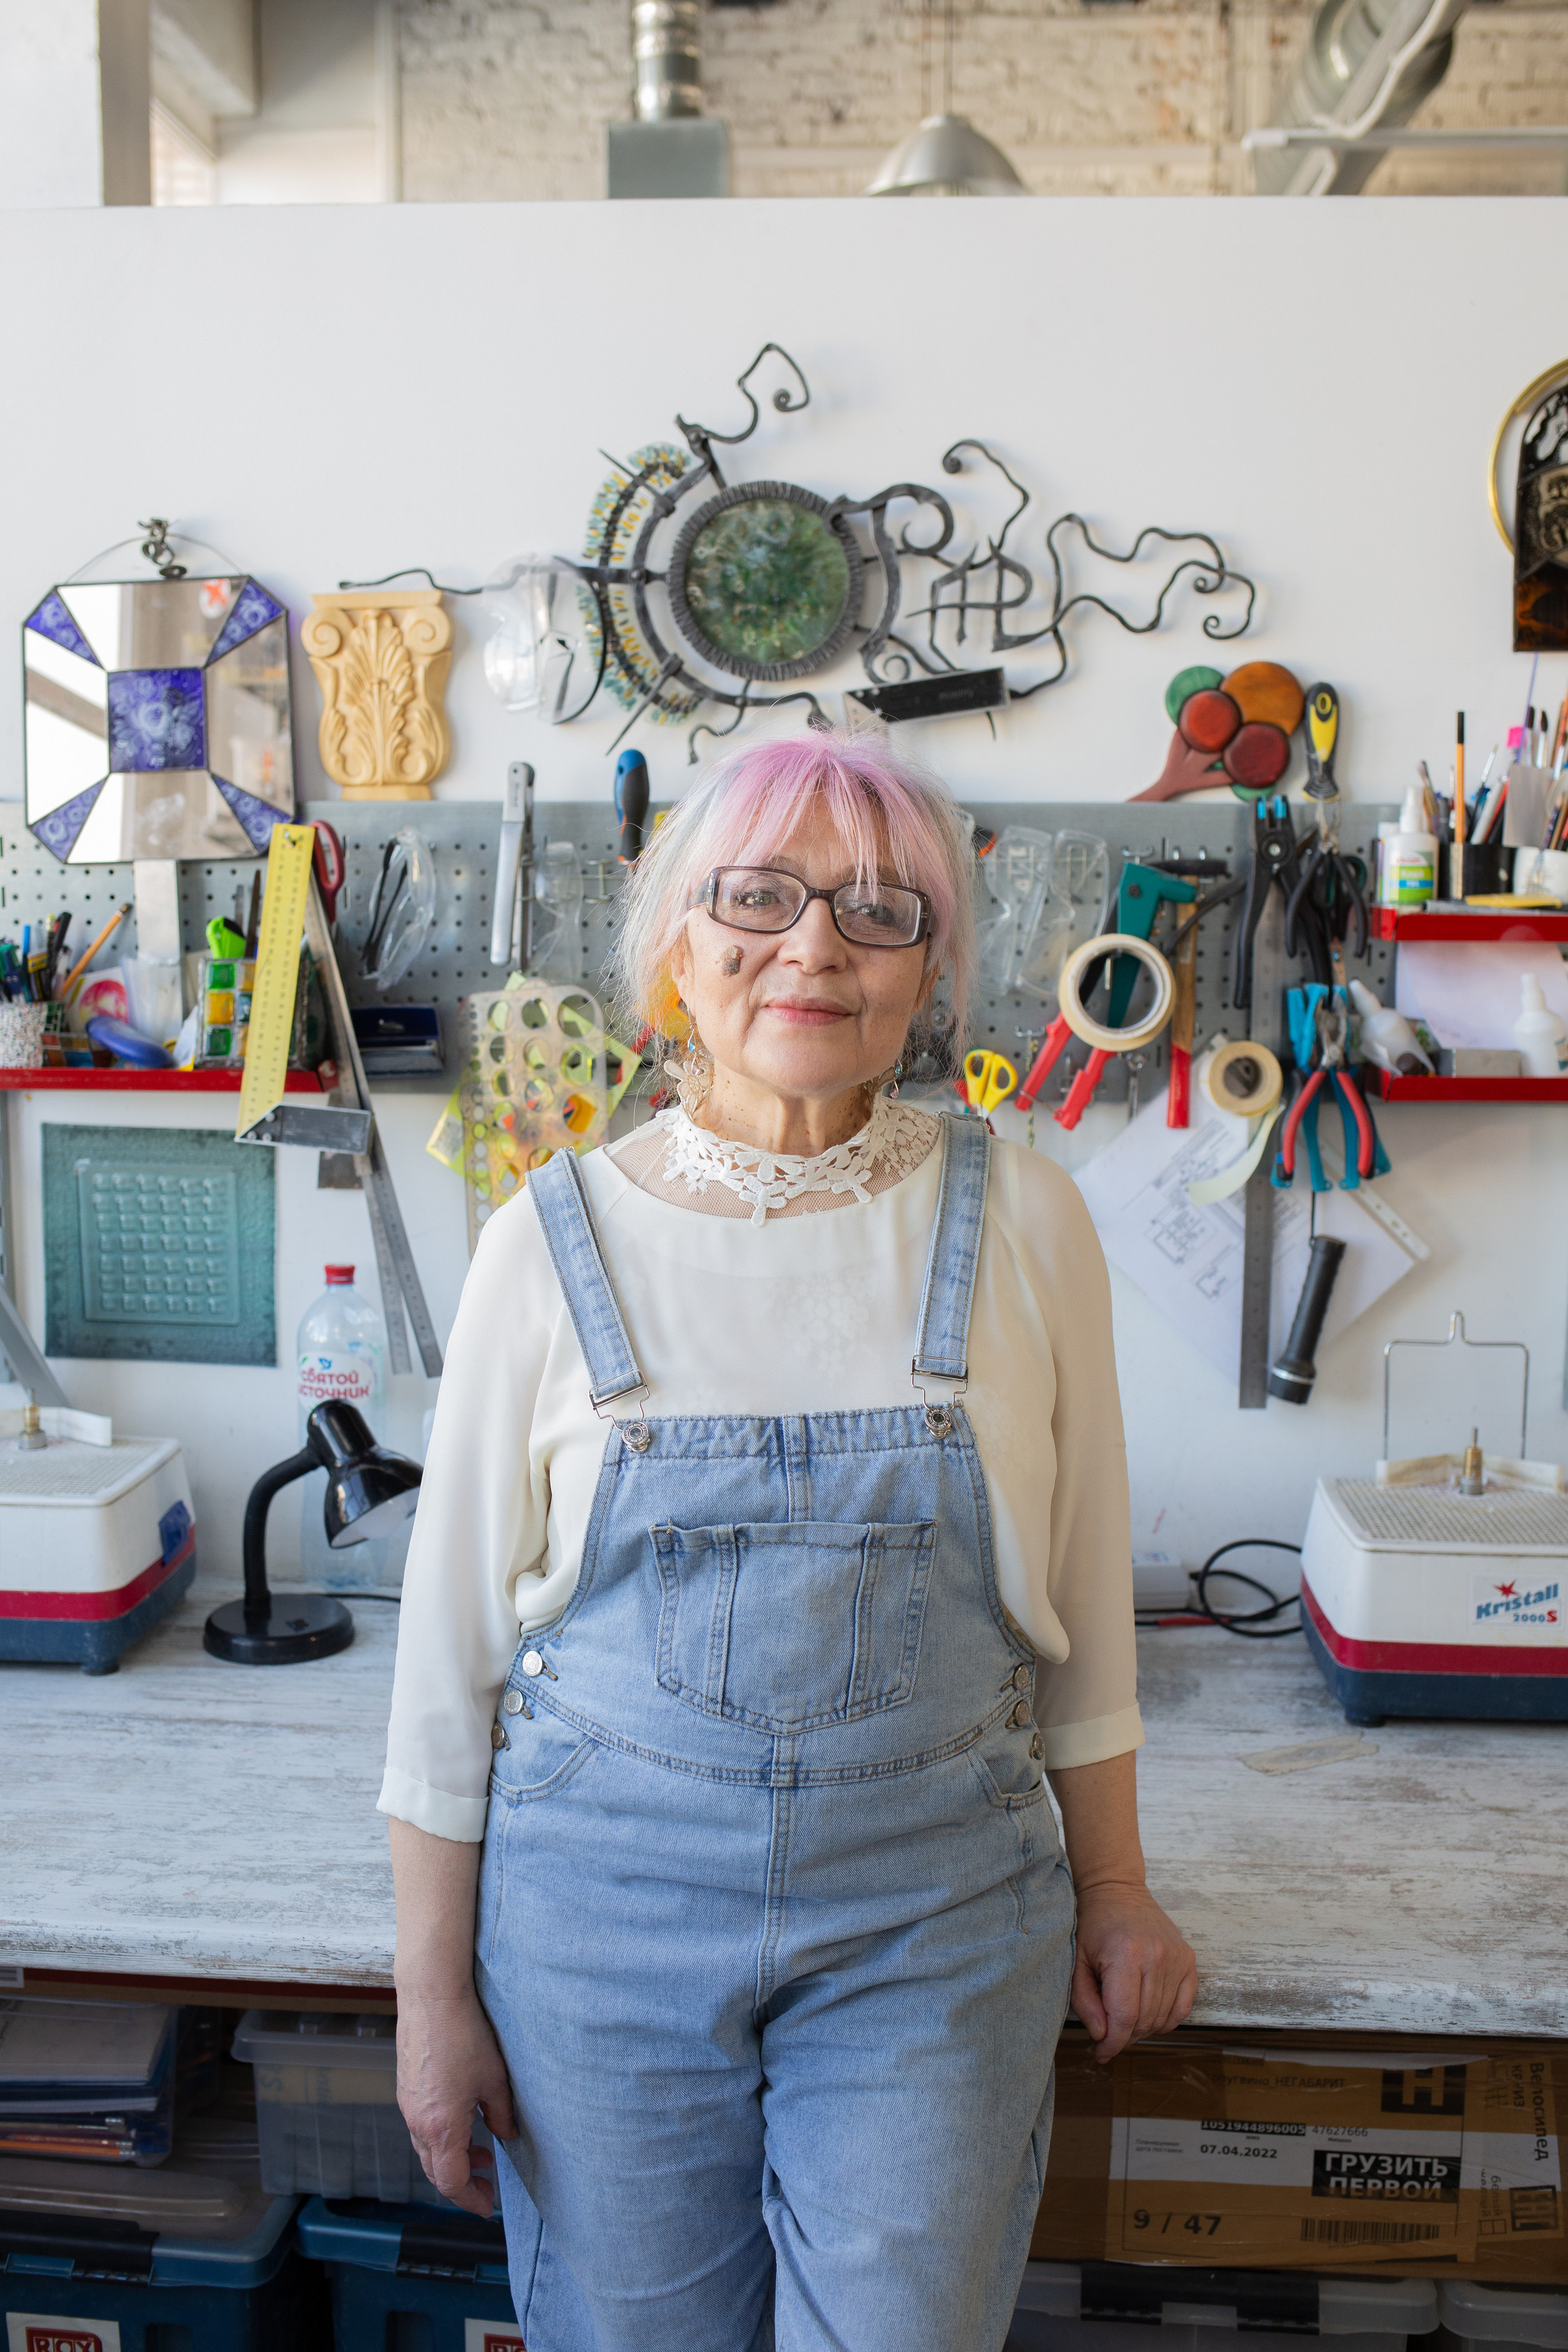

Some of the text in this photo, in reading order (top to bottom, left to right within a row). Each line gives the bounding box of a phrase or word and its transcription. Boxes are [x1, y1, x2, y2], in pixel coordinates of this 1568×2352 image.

[1477, 1582, 1559, 1619] Kristall
[1312, 2125, 1368, 2137] 47627666
[1200, 2144, 1278, 2158] 07.04.2022
[1325, 2152, 1449, 2177] ГРУЗИТЬ
[1329, 2176, 1442, 2200] ПЕРВОЙ
[1134, 2209, 1150, 2229] 9
[1184, 2215, 1222, 2236] 47
